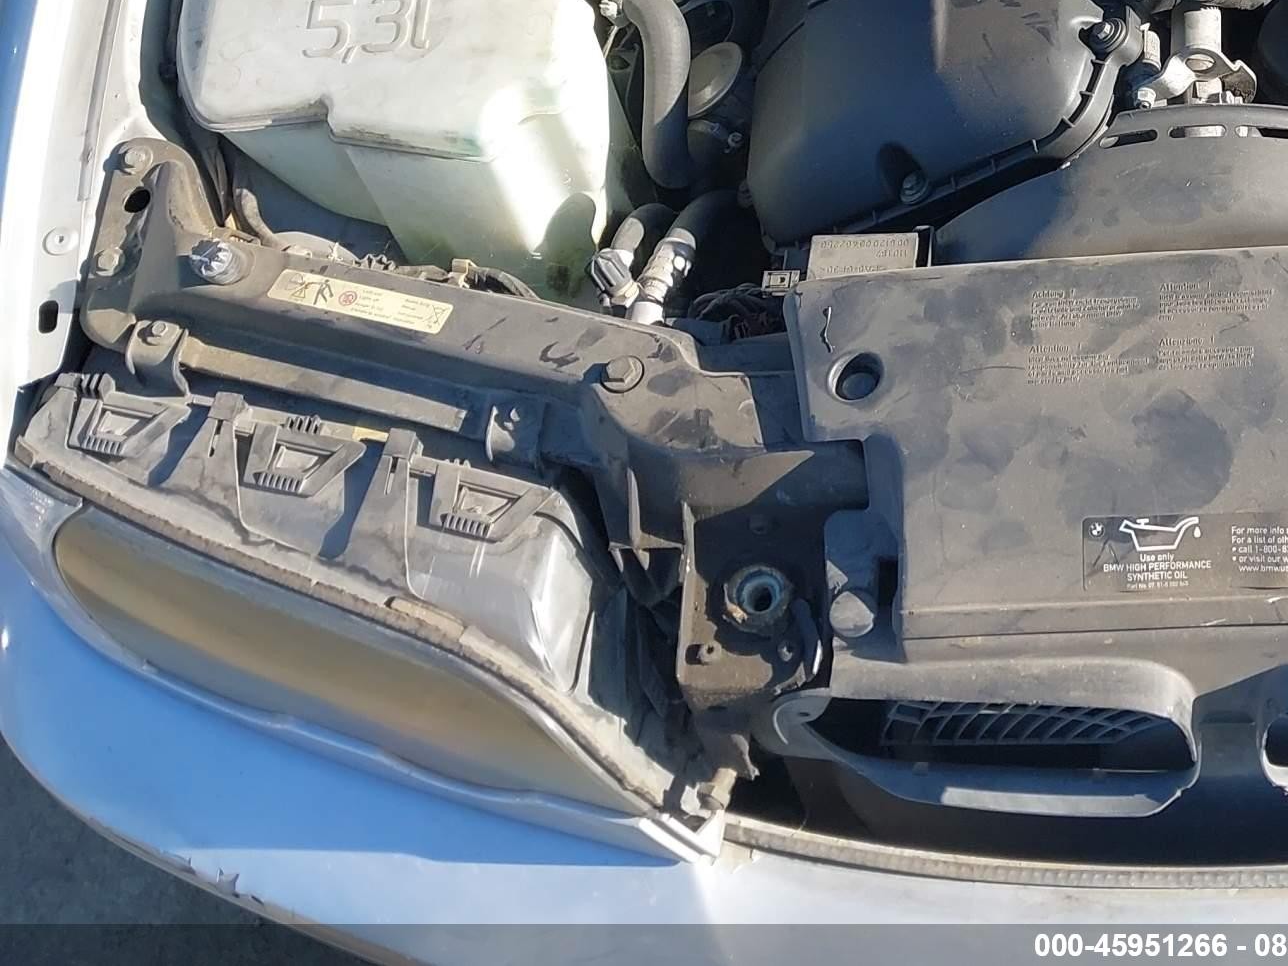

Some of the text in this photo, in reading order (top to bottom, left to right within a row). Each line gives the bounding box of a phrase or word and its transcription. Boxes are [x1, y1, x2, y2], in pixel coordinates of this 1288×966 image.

[1231, 526, 1245, 535] For
[1247, 527, 1268, 535] more
[1270, 526, 1284, 534] info
[1231, 536, 1245, 544] For
[1254, 535, 1267, 544] list
[1268, 535, 1276, 543] of
[1238, 545, 1253, 554] call
[1140, 552, 1175, 562] Use only
[1238, 555, 1248, 563] or
[1249, 554, 1265, 563] visit
[1267, 555, 1280, 563] our
[1103, 560, 1212, 572] BMW HIGH PERFORMANCE
[1127, 571, 1188, 581] SYNTHETIC OIL
